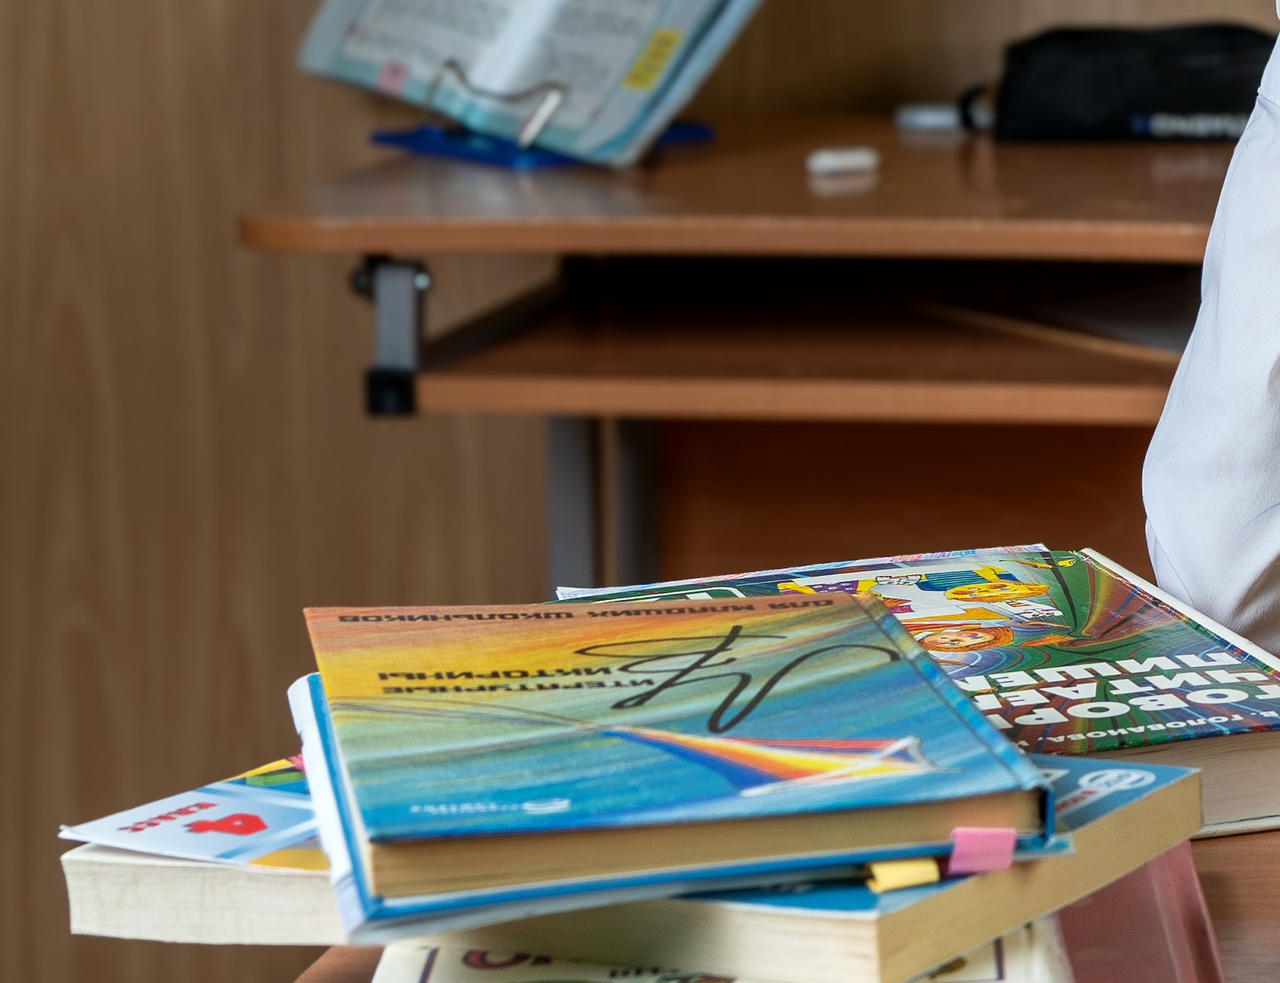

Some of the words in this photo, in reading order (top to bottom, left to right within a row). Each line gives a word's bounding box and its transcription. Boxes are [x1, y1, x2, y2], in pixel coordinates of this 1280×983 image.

[590, 603, 755, 618] МЛАДШИХ
[769, 599, 834, 609] ДЛЯ
[338, 611, 574, 623] ШКОЛЬНИКОВ
[1251, 710, 1279, 718] В.
[1037, 714, 1244, 743] ГОЛОВАНОВА,
[182, 812, 269, 836] 4
